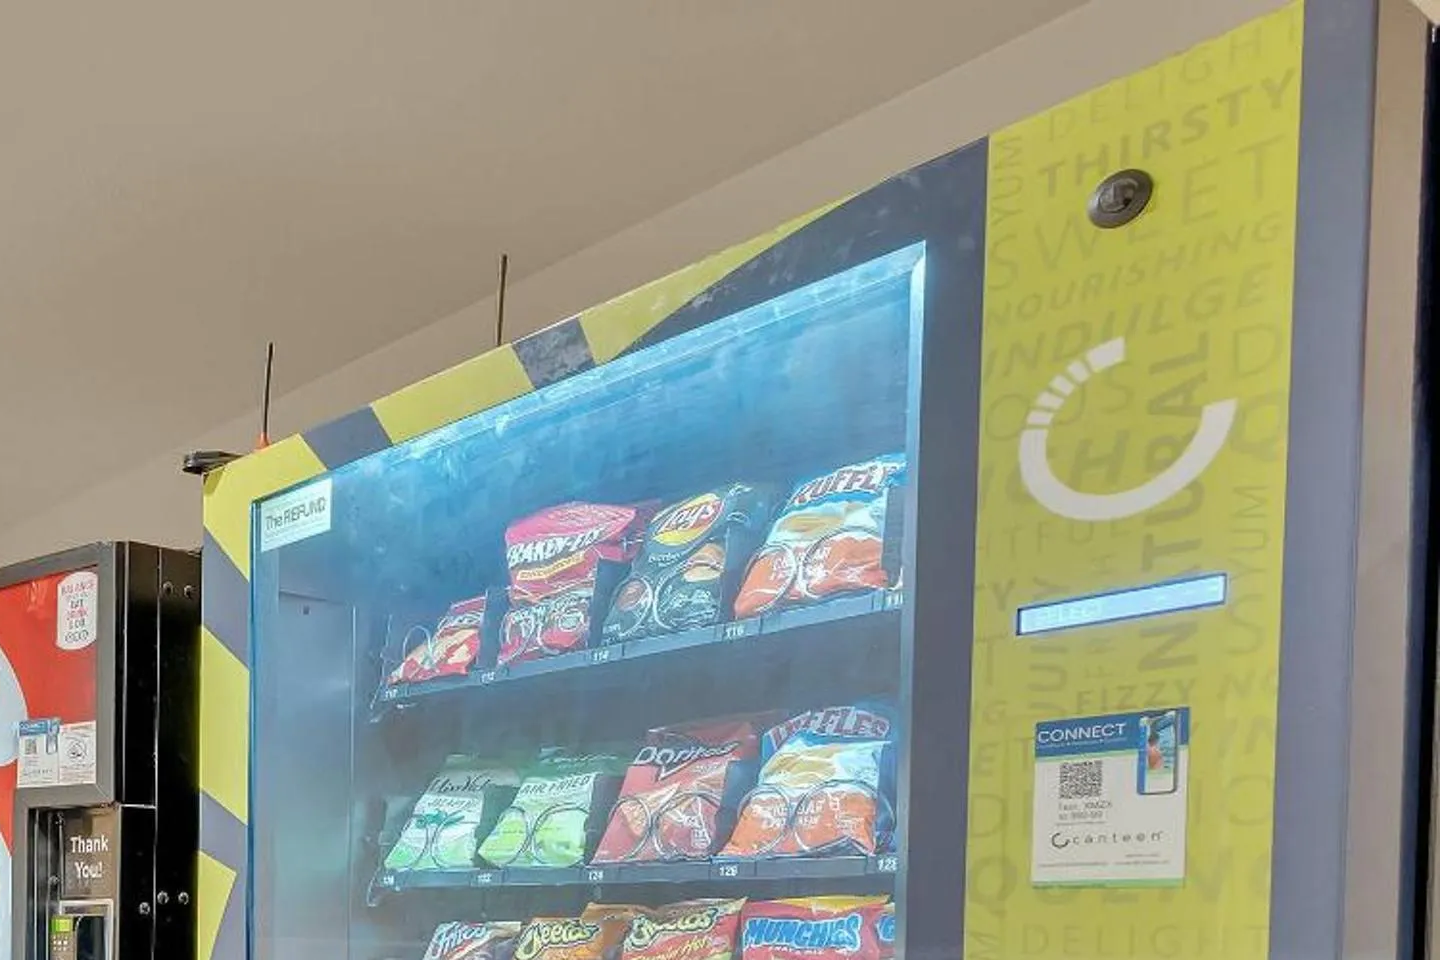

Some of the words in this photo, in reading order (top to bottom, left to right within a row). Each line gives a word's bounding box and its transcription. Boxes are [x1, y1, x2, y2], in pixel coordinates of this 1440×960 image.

[1037, 67, 1296, 198] THIRSTY
[1037, 723, 1127, 744] CONNECT
[70, 834, 109, 853] Thank
[1072, 831, 1162, 845] canteen
[74, 861, 103, 879] You!
[743, 914, 861, 950] MUNCHIES
